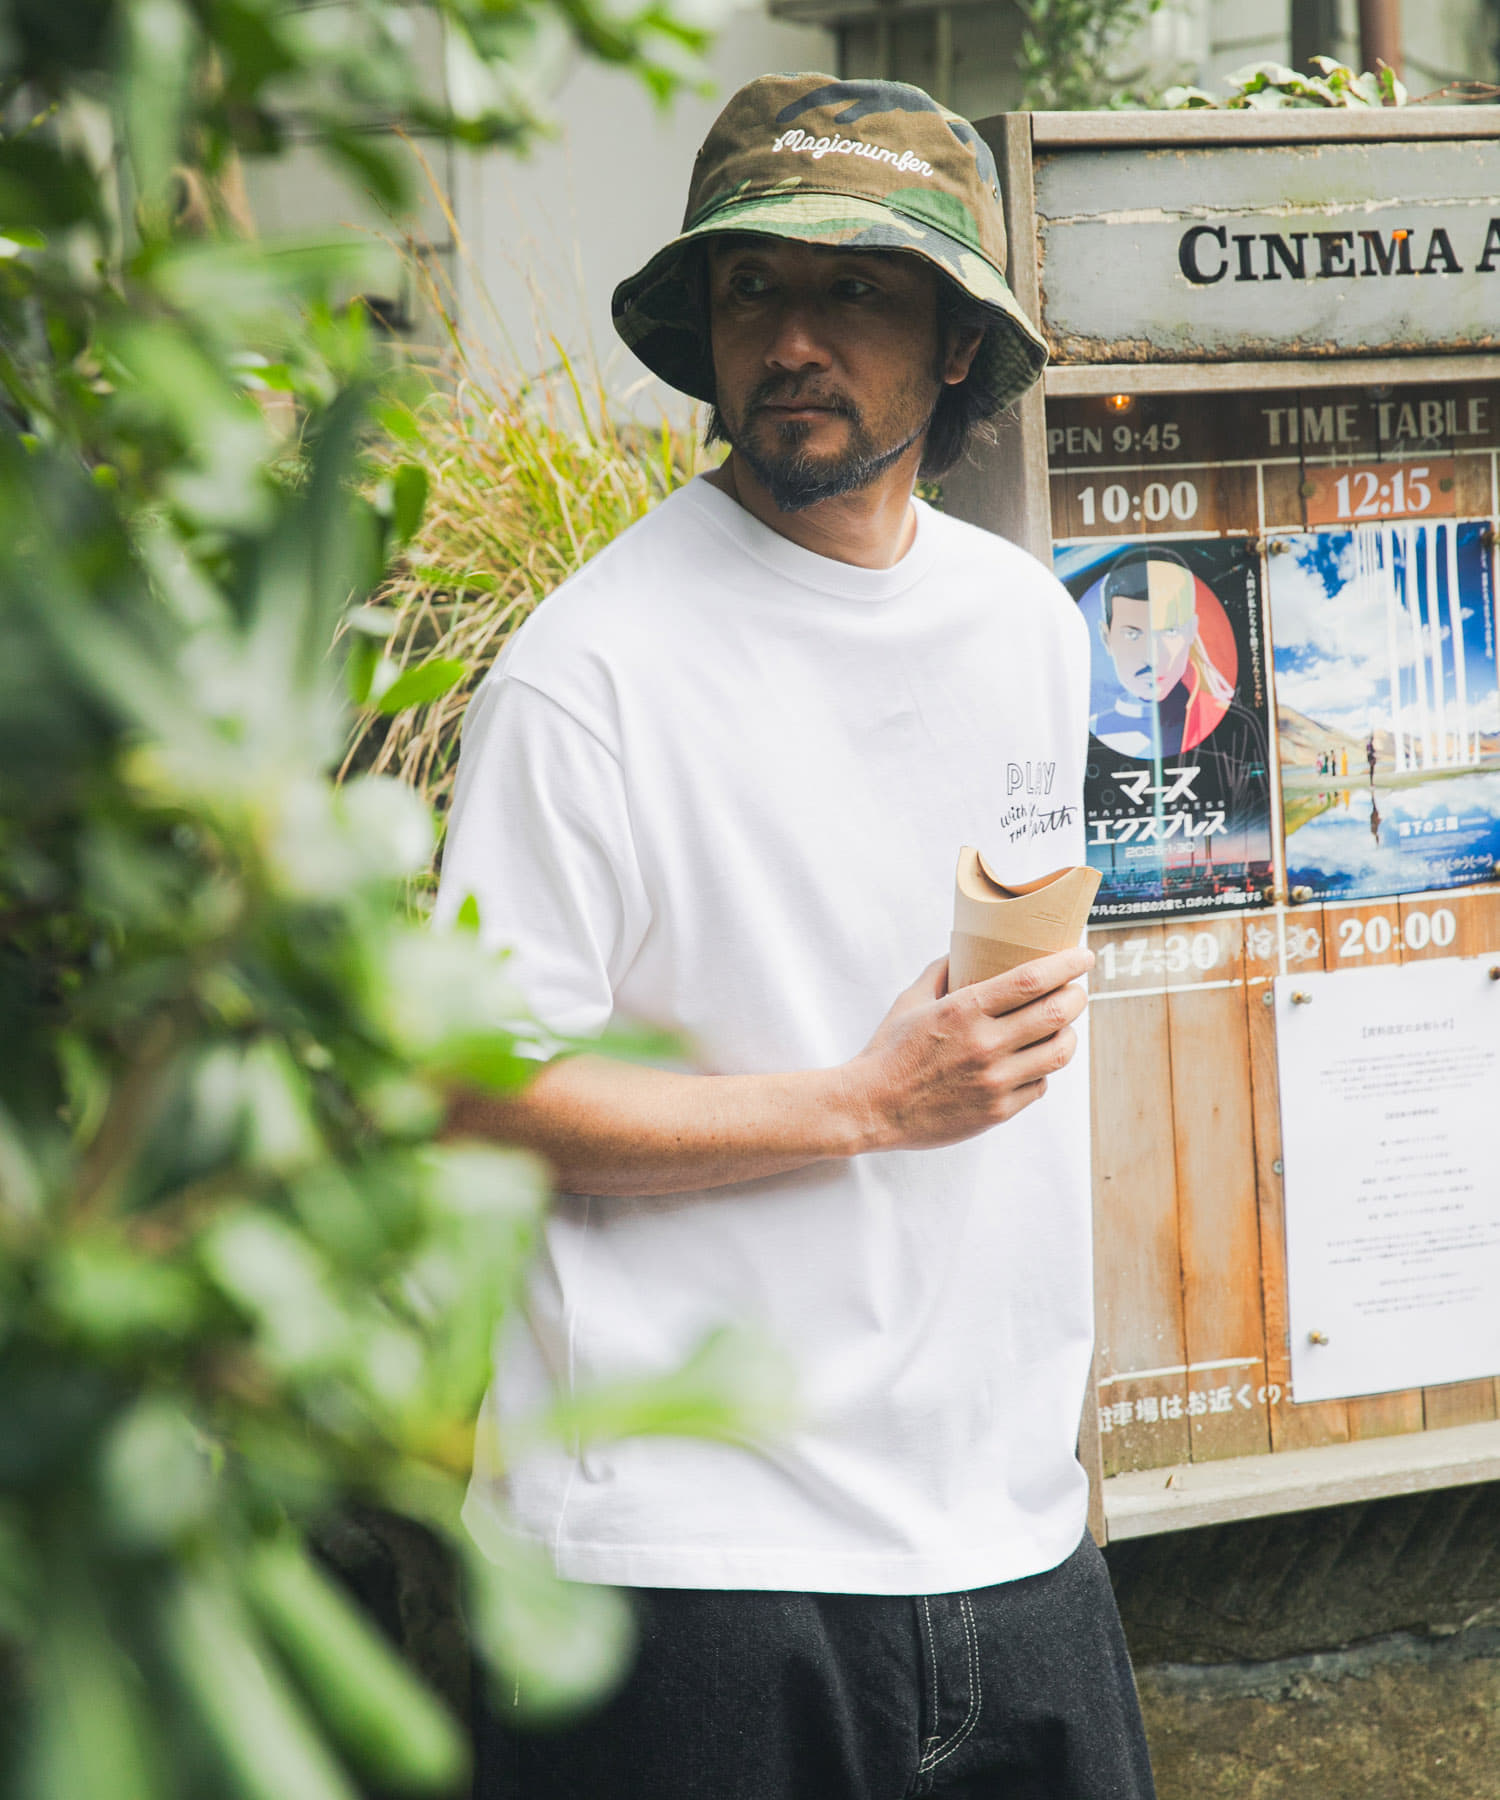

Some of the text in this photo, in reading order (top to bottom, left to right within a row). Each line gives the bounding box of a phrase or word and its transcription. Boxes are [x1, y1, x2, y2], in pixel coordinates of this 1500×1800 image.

[1178, 225, 1464, 285] CINEMA
[1112, 423, 1180, 453] 9:45
[1262, 398, 1489, 446] TIME TABLE
[1077, 480, 1198, 526] 10:00
[1335, 467, 1431, 518] 12:15
[1110, 766, 1200, 805] マース
[1087, 811, 1228, 845] エクスプレス
[1098, 932, 1219, 980] 17:30
[1339, 908, 1457, 958] 20:00
